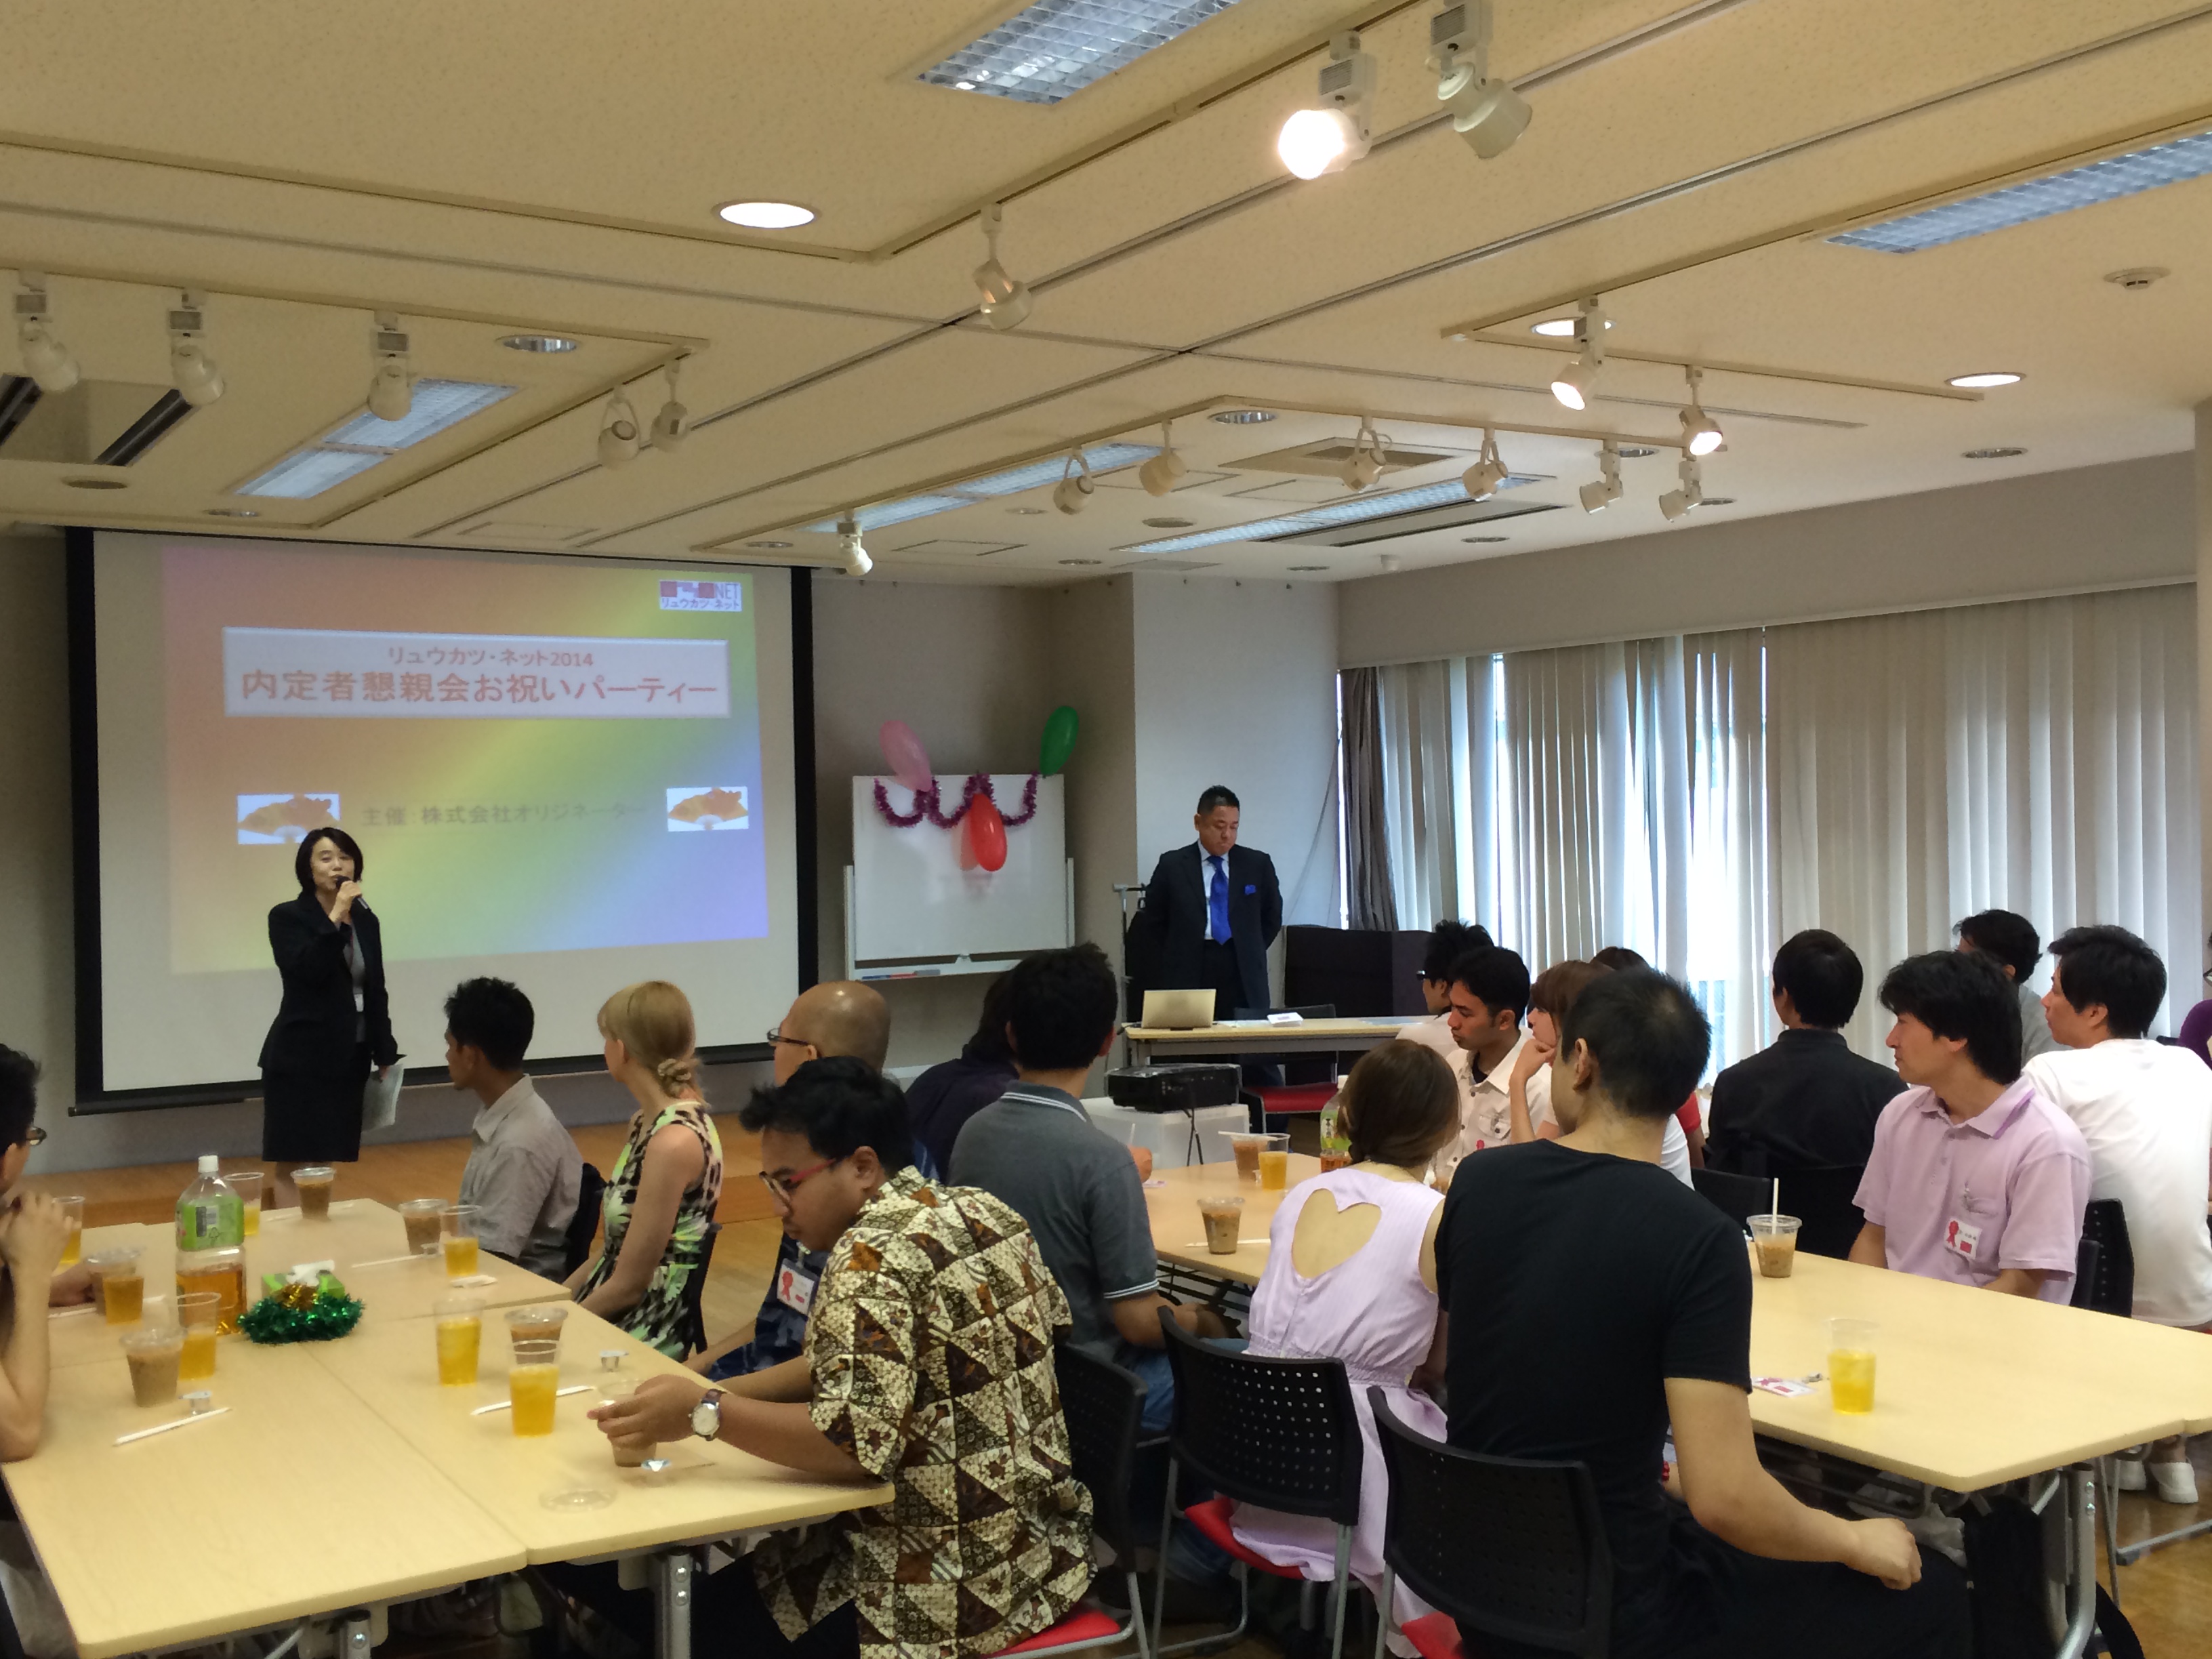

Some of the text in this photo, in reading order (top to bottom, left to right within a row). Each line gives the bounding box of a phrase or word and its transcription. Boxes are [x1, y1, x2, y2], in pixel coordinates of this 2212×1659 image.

[716, 583, 739, 598] NET
[388, 647, 594, 667] リュウカツ・ネット2014
[241, 669, 717, 703] 内定者懇親会お祝いパーティー
